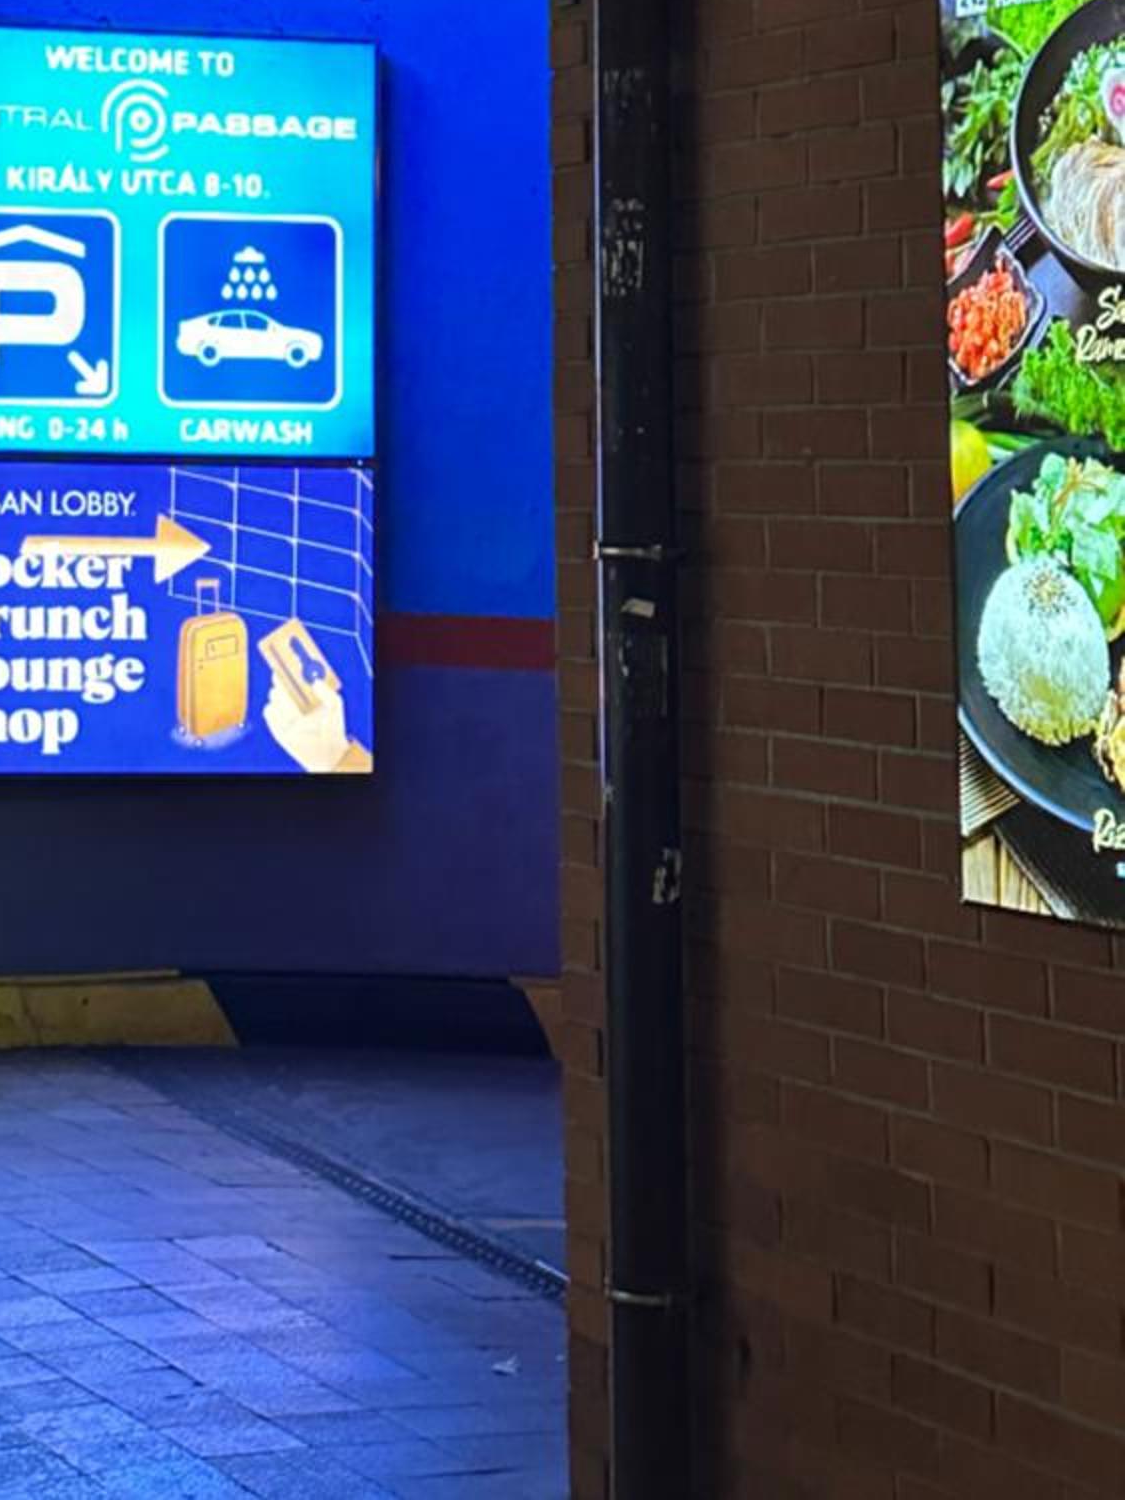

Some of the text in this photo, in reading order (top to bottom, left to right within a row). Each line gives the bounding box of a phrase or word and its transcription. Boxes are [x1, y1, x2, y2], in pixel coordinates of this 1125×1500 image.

[45, 45, 234, 78] WELCOME TO
[172, 111, 358, 140] PASSAGE
[6, 161, 113, 193] KIRÁLY
[121, 169, 196, 195] UTCA
[181, 418, 313, 445] CARWASH
